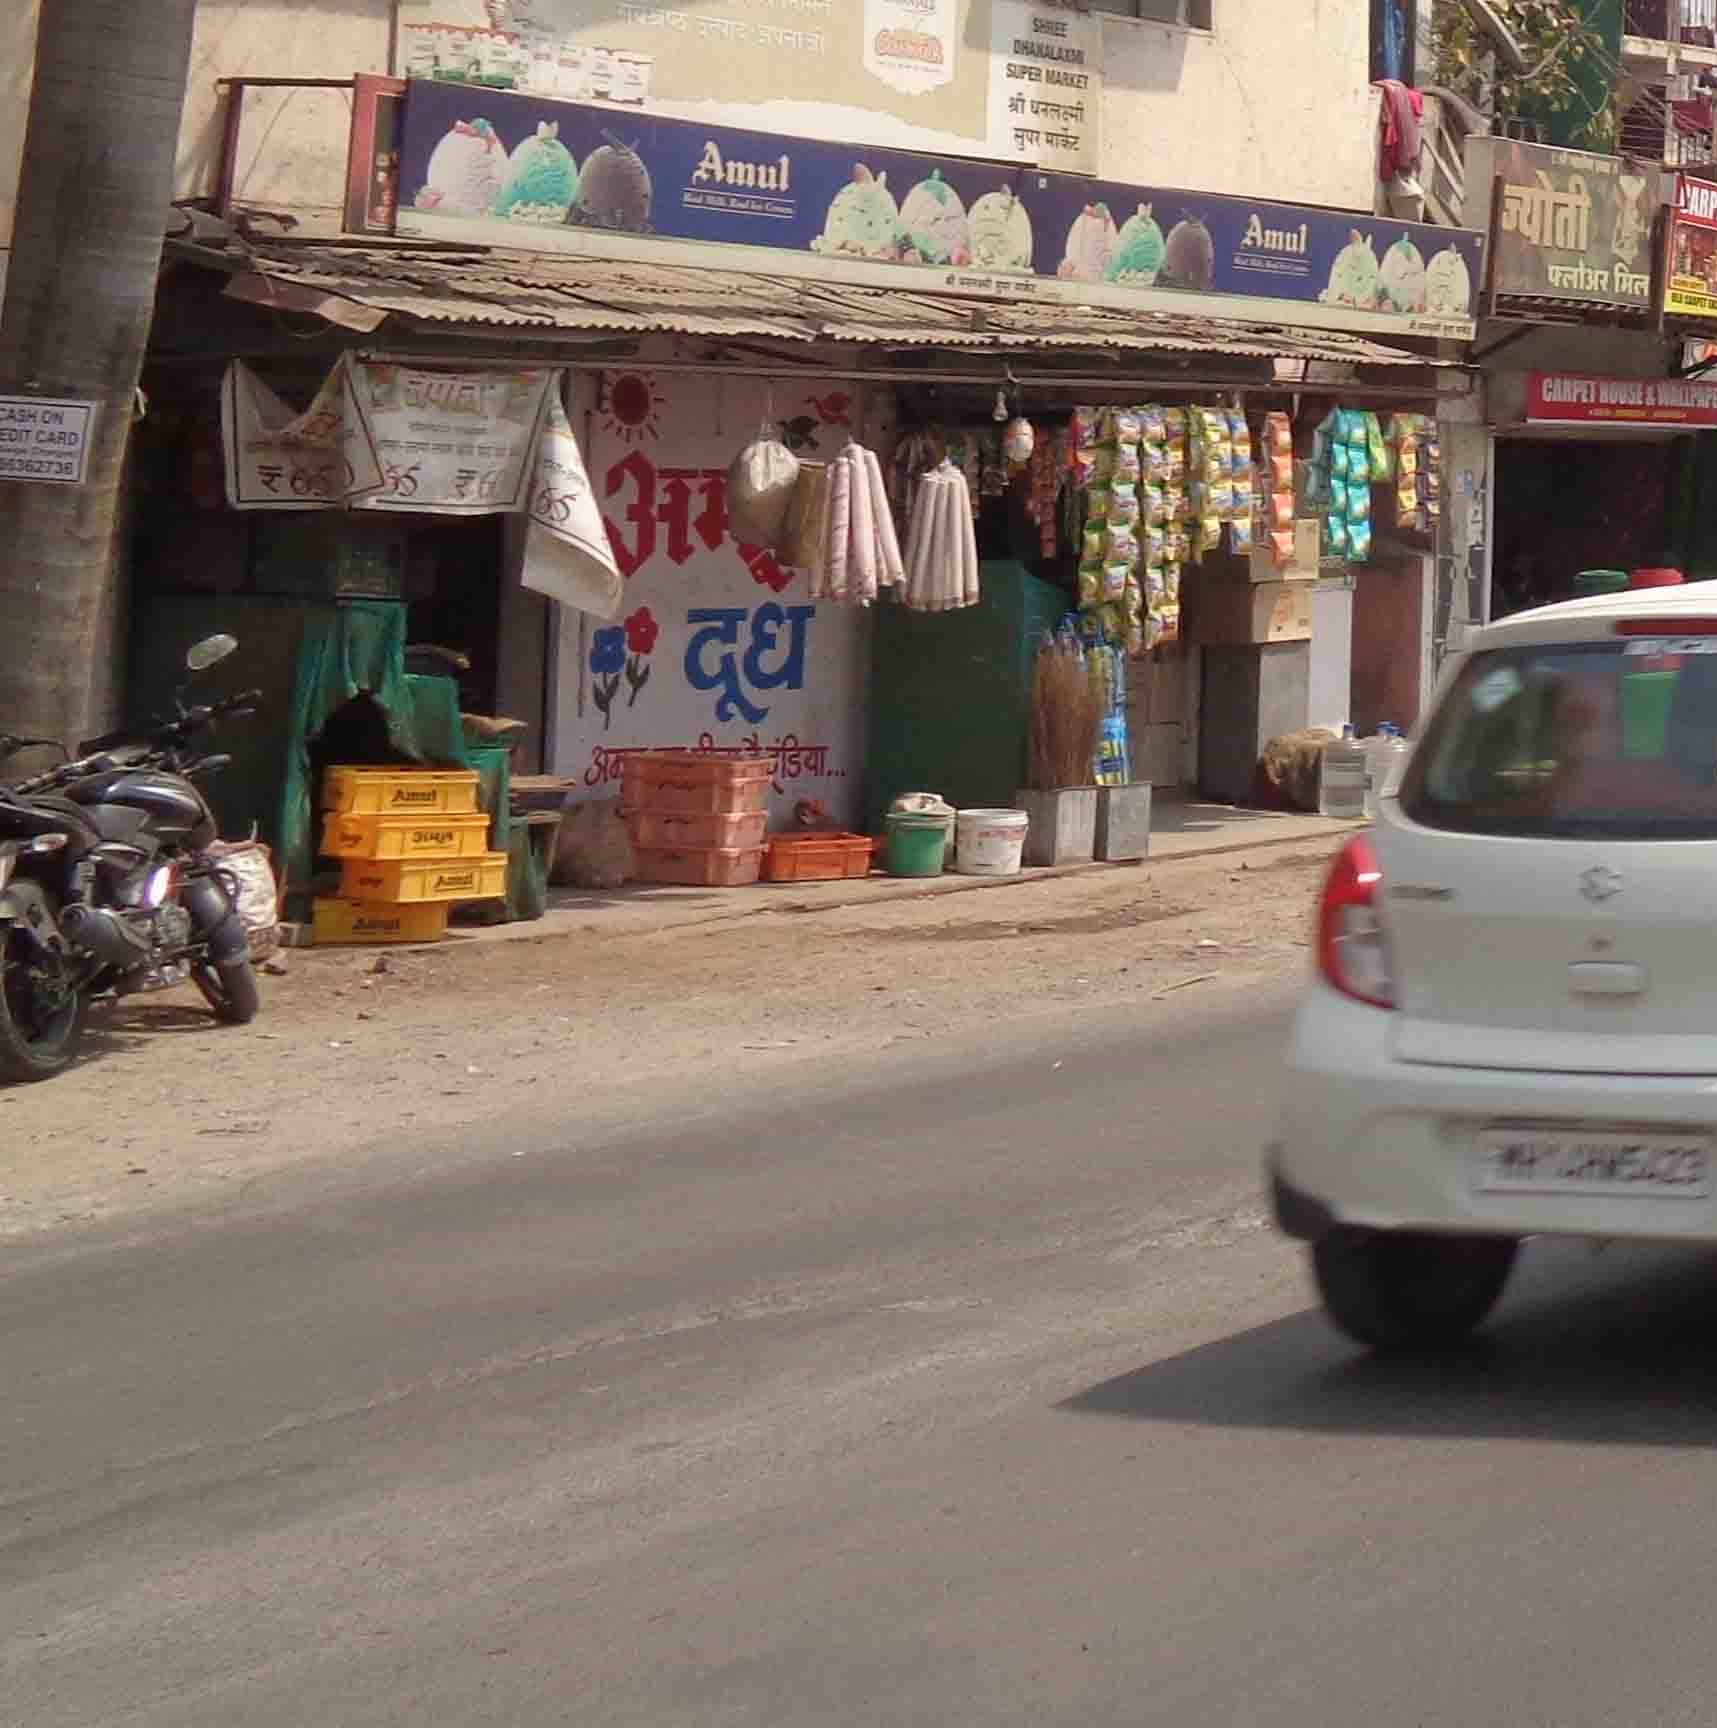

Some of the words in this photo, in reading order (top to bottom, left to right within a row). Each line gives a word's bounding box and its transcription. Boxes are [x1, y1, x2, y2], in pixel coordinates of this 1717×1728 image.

[1004, 62, 1043, 84] SUPER
[1045, 68, 1089, 90] MARKET
[692, 139, 790, 192] Amul
[1240, 213, 1308, 254] Amul
[1600, 379, 1643, 405] HOUSE
[41, 410, 64, 425] ON
[36, 430, 80, 447] CARD
[684, 601, 816, 724] दूध
[391, 788, 437, 805] Amul
